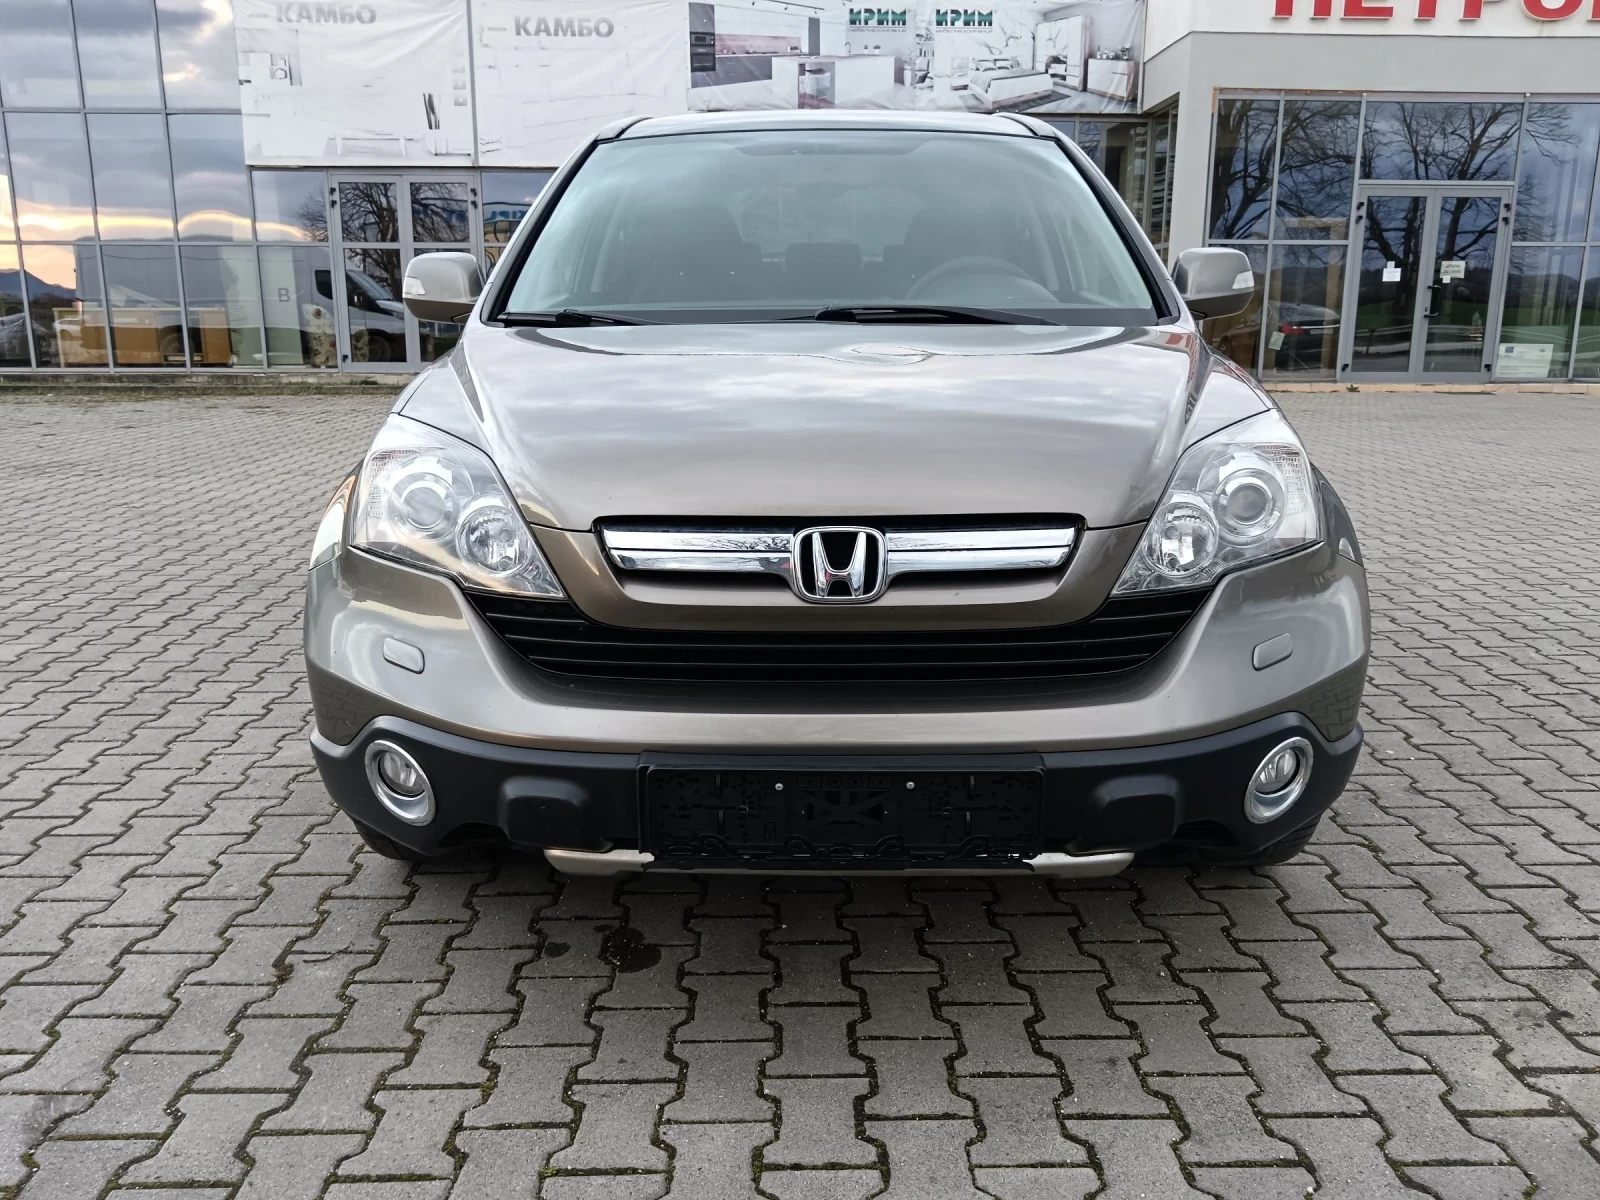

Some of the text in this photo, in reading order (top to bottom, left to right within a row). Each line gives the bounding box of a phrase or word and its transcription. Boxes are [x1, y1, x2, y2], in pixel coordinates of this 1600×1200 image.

[276, 2, 377, 25] КАМБО
[849, 8, 907, 26] ИРИМ
[935, 9, 993, 27] ИРИМ
[514, 16, 615, 38] КАМБО
